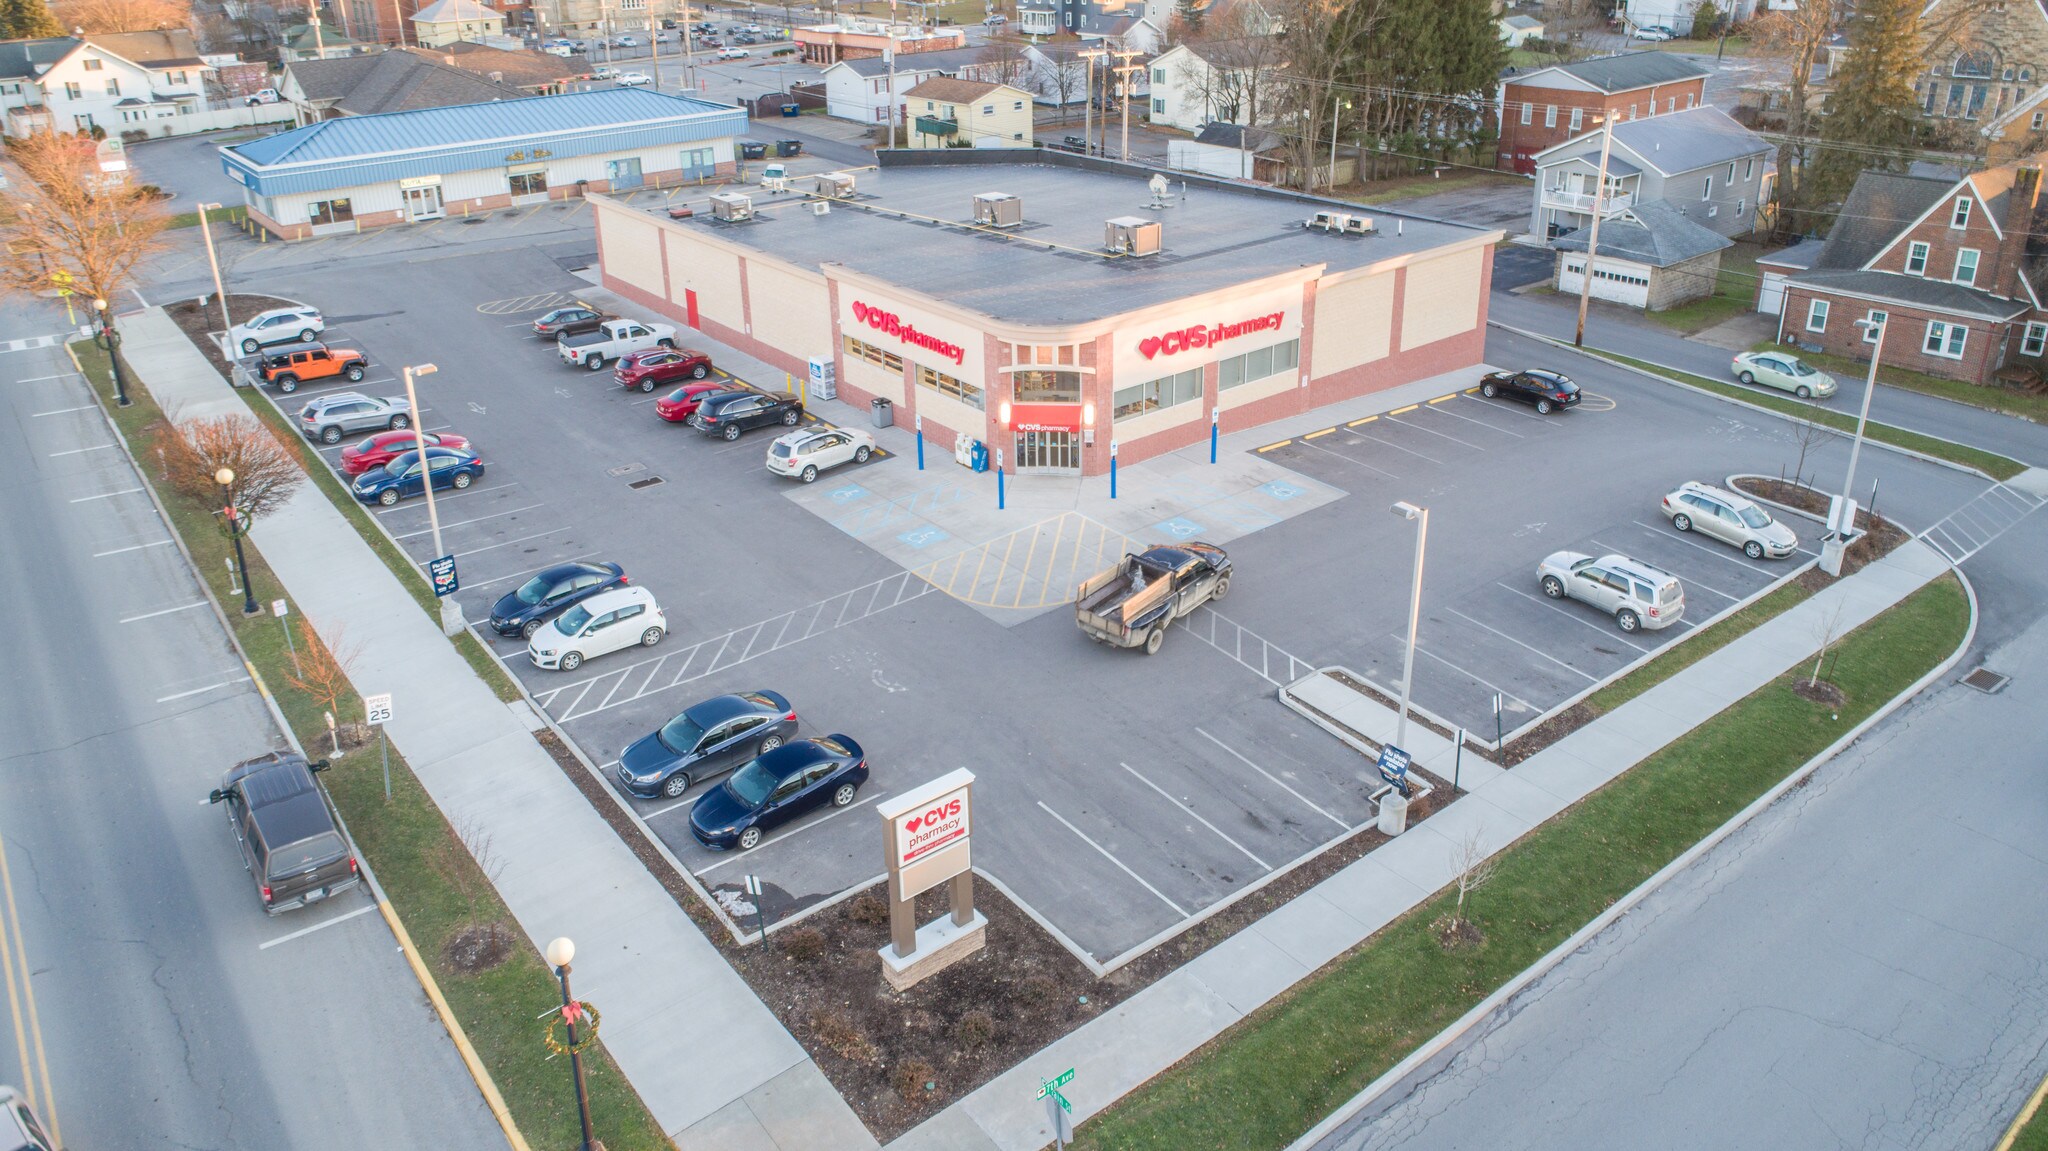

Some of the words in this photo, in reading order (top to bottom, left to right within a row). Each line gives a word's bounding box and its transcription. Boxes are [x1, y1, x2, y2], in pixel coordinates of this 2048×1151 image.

[867, 307, 901, 337] CVS
[900, 324, 965, 366] pharmacy
[1161, 324, 1208, 355] CVS
[1208, 311, 1285, 348] pharmacy
[368, 696, 390, 704] SPEED
[370, 708, 391, 721] 25
[1383, 755, 1405, 769] available
[1385, 748, 1394, 757] Flu
[1393, 752, 1408, 764] shots
[924, 799, 961, 827] CVS
[909, 817, 961, 849] pharmacy
[1046, 1080, 1059, 1093] 7th
[1061, 1072, 1073, 1084] Ave
